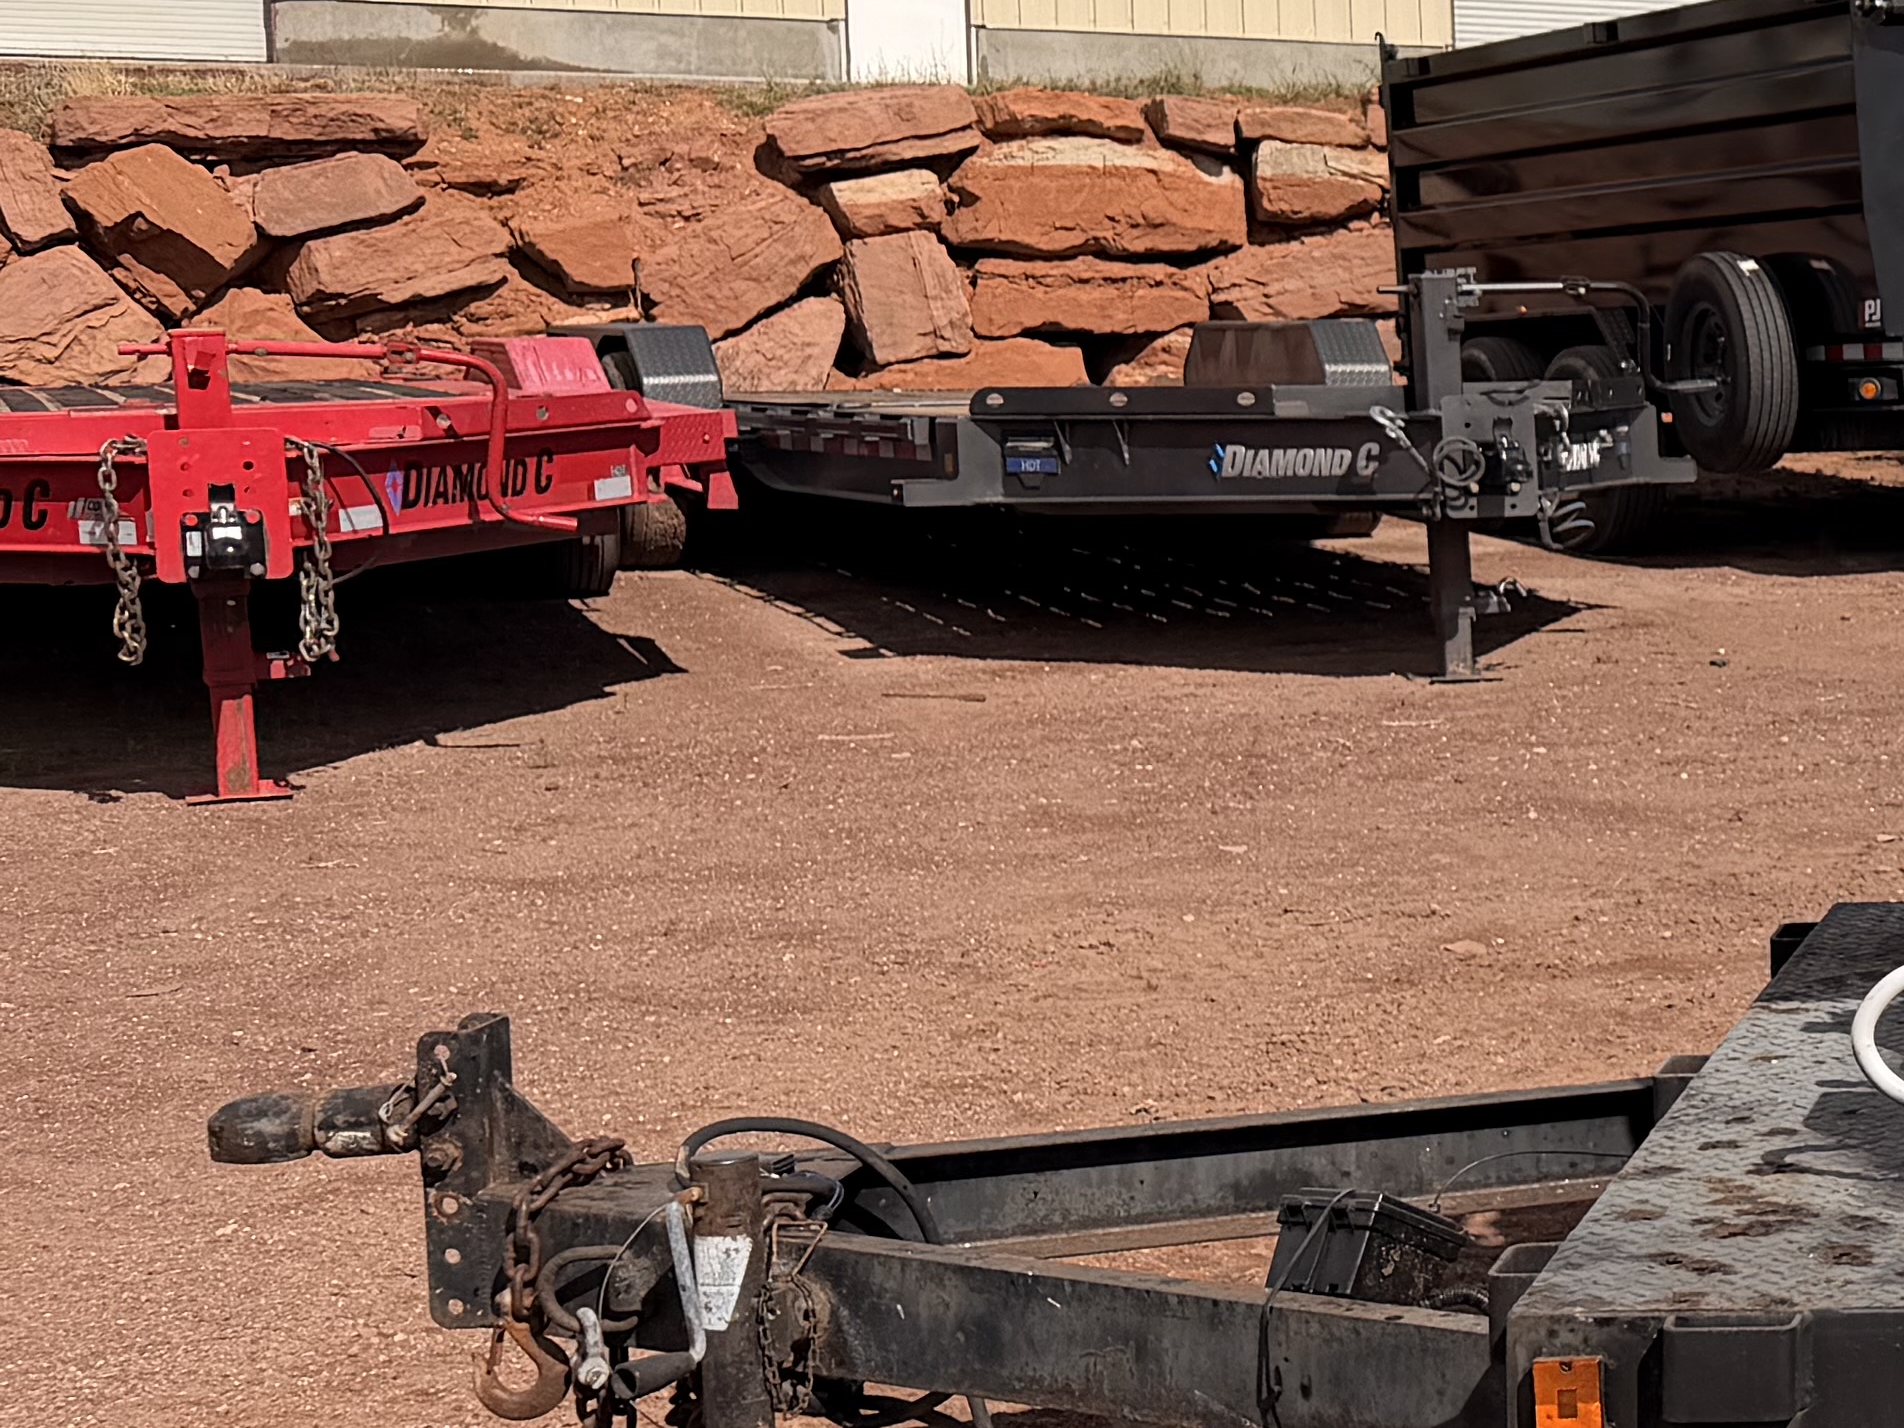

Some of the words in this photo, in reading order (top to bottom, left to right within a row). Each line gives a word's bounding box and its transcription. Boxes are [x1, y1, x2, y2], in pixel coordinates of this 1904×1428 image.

[534, 447, 554, 495] C
[1222, 444, 1353, 479] DIAMOND
[1356, 441, 1381, 477] C
